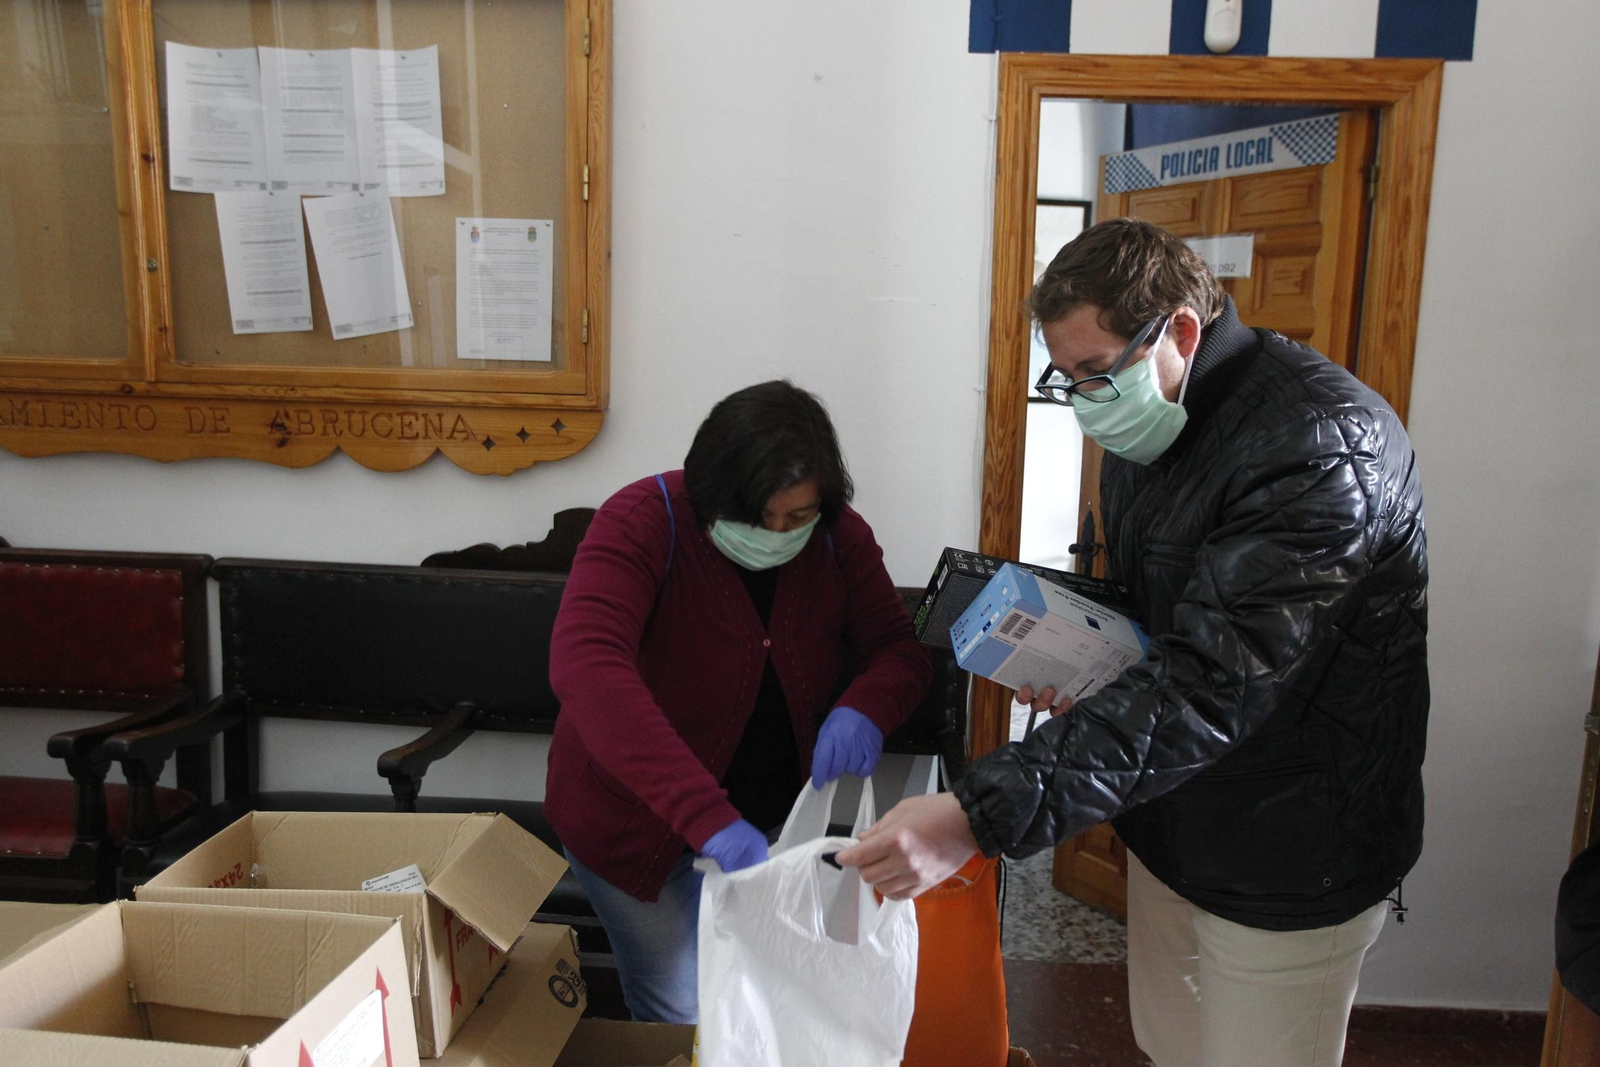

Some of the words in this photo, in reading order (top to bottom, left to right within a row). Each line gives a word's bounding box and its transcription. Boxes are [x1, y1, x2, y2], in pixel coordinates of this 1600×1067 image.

[1160, 145, 1220, 180] POLICIA
[1225, 137, 1274, 169] LOCAL
[0, 399, 157, 432] MIENTO
[183, 406, 230, 435] DE
[267, 408, 477, 441] ABRUCENA
